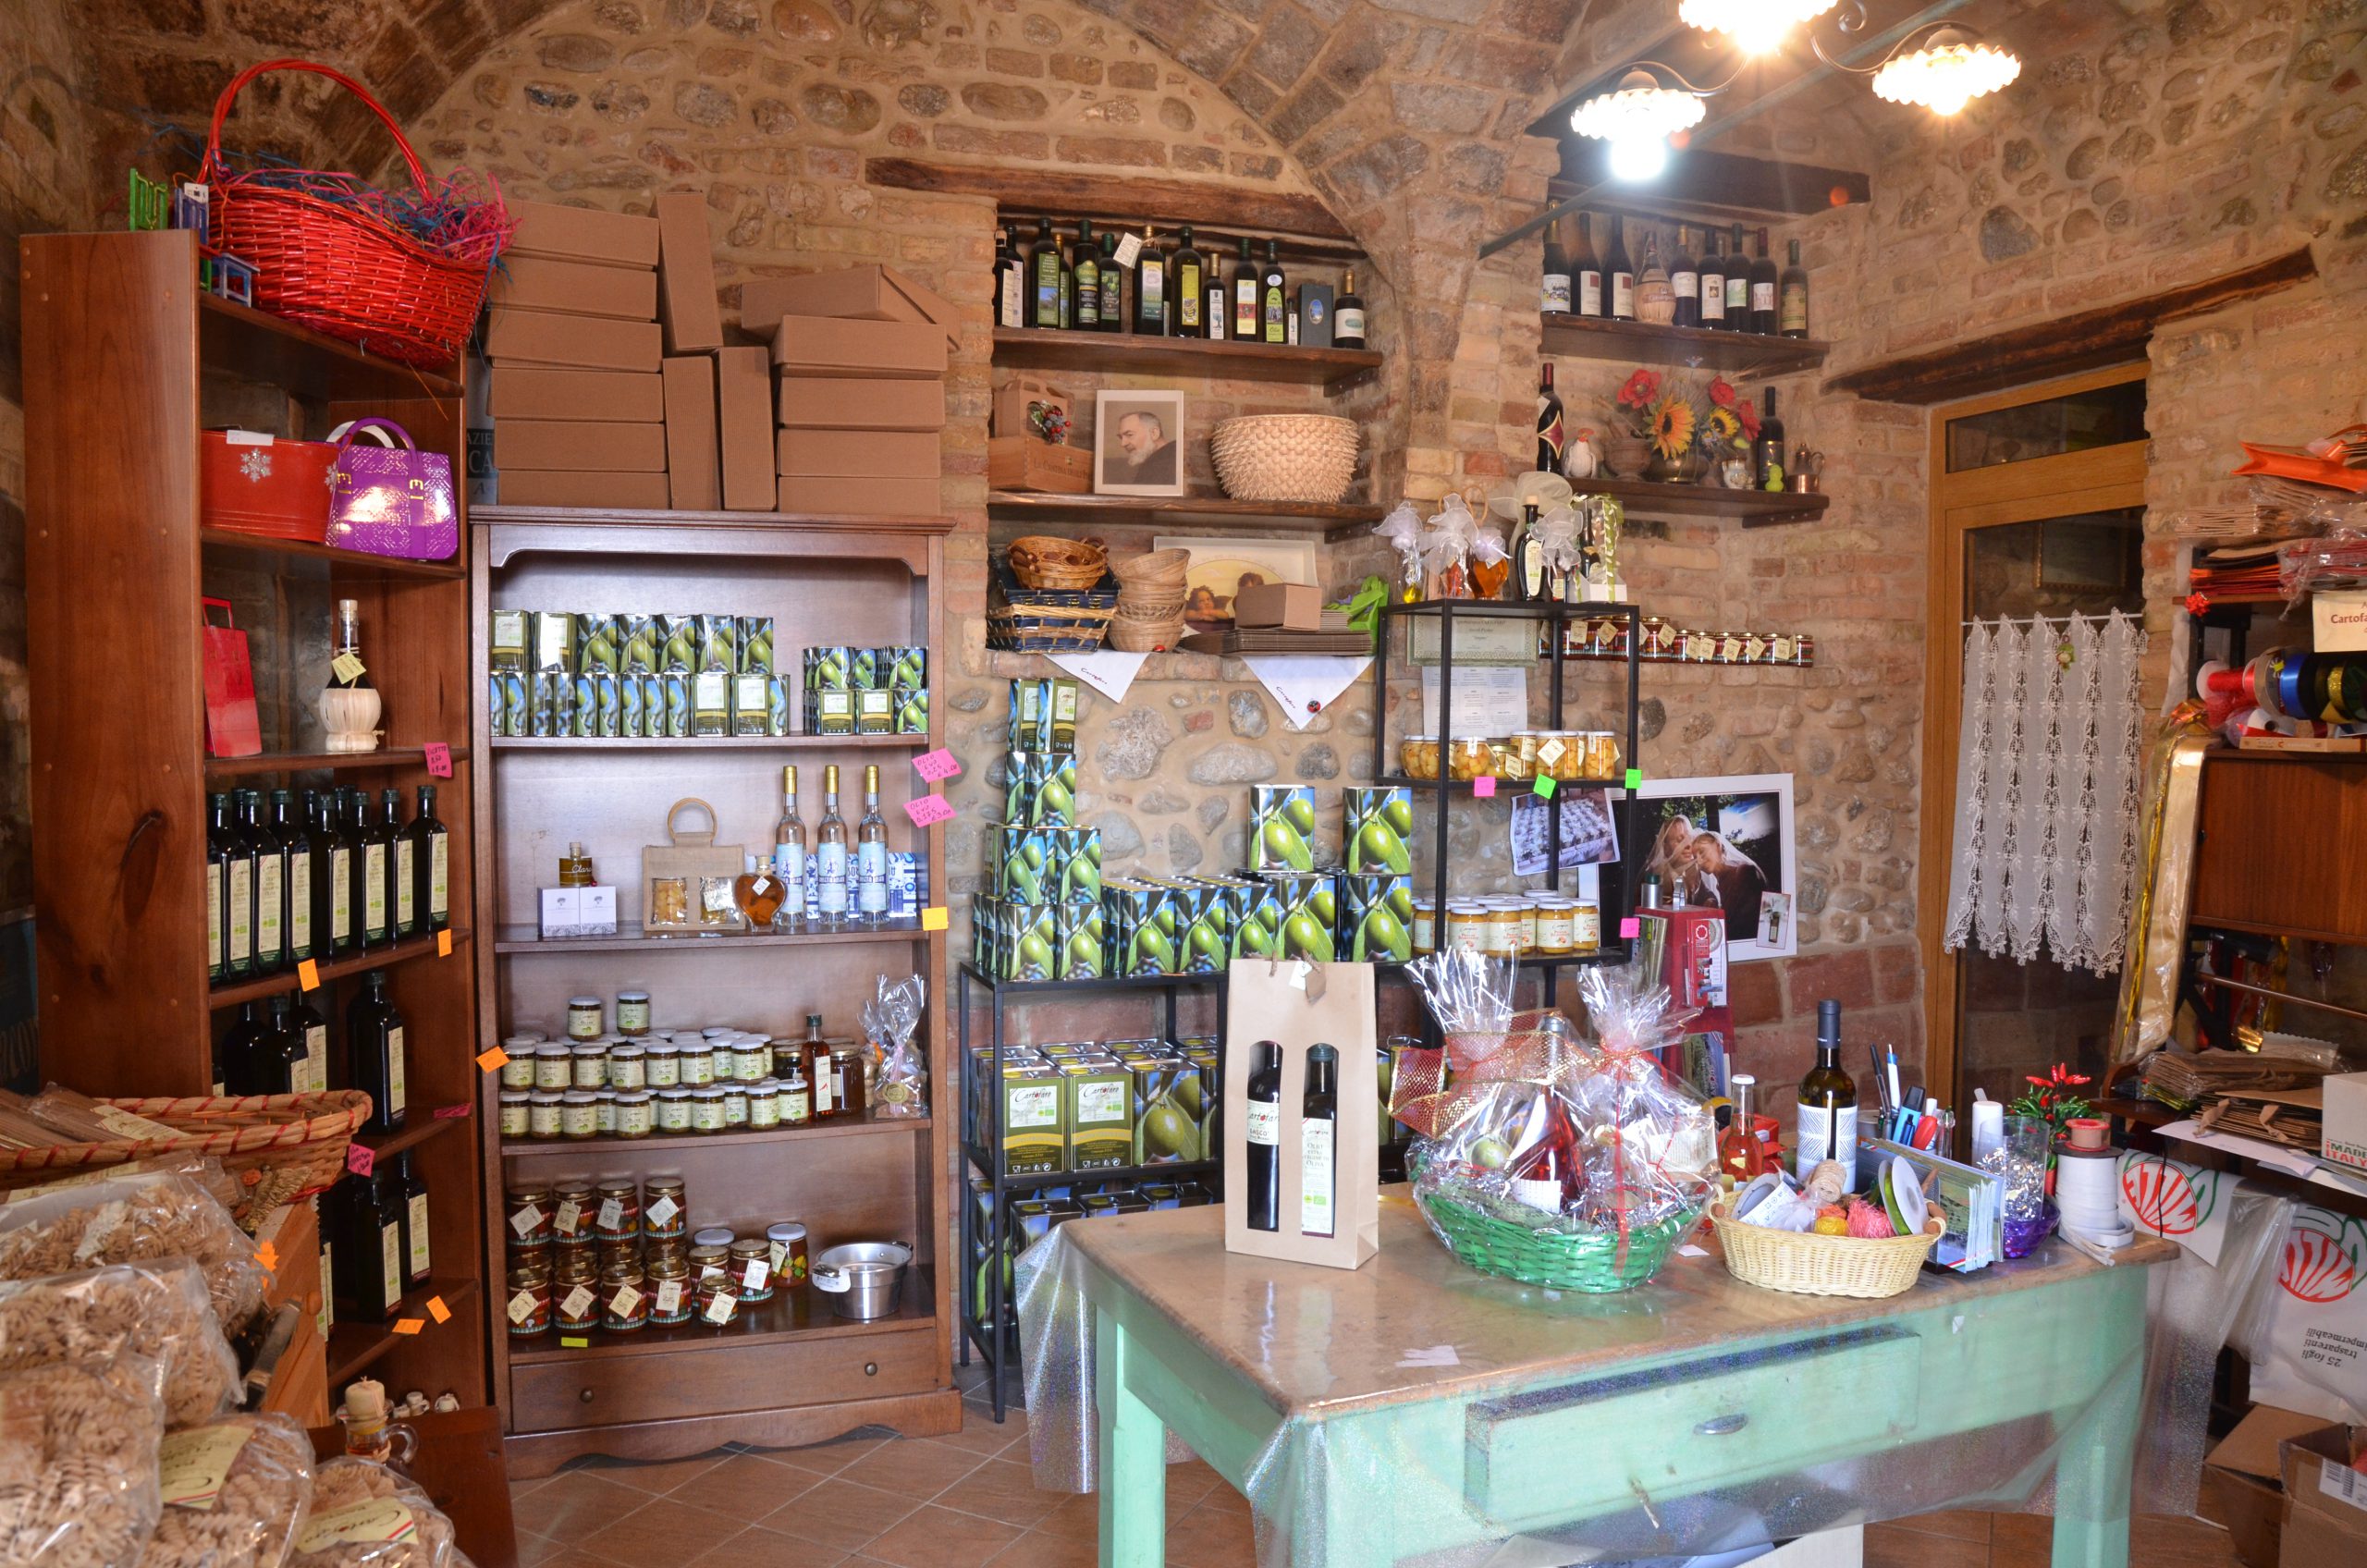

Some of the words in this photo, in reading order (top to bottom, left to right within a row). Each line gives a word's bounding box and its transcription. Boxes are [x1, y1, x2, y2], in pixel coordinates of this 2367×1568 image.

[2303, 1338, 2358, 1360] trasparenti
[2301, 1350, 2325, 1364] fogli
[2326, 1356, 2342, 1367] 25
